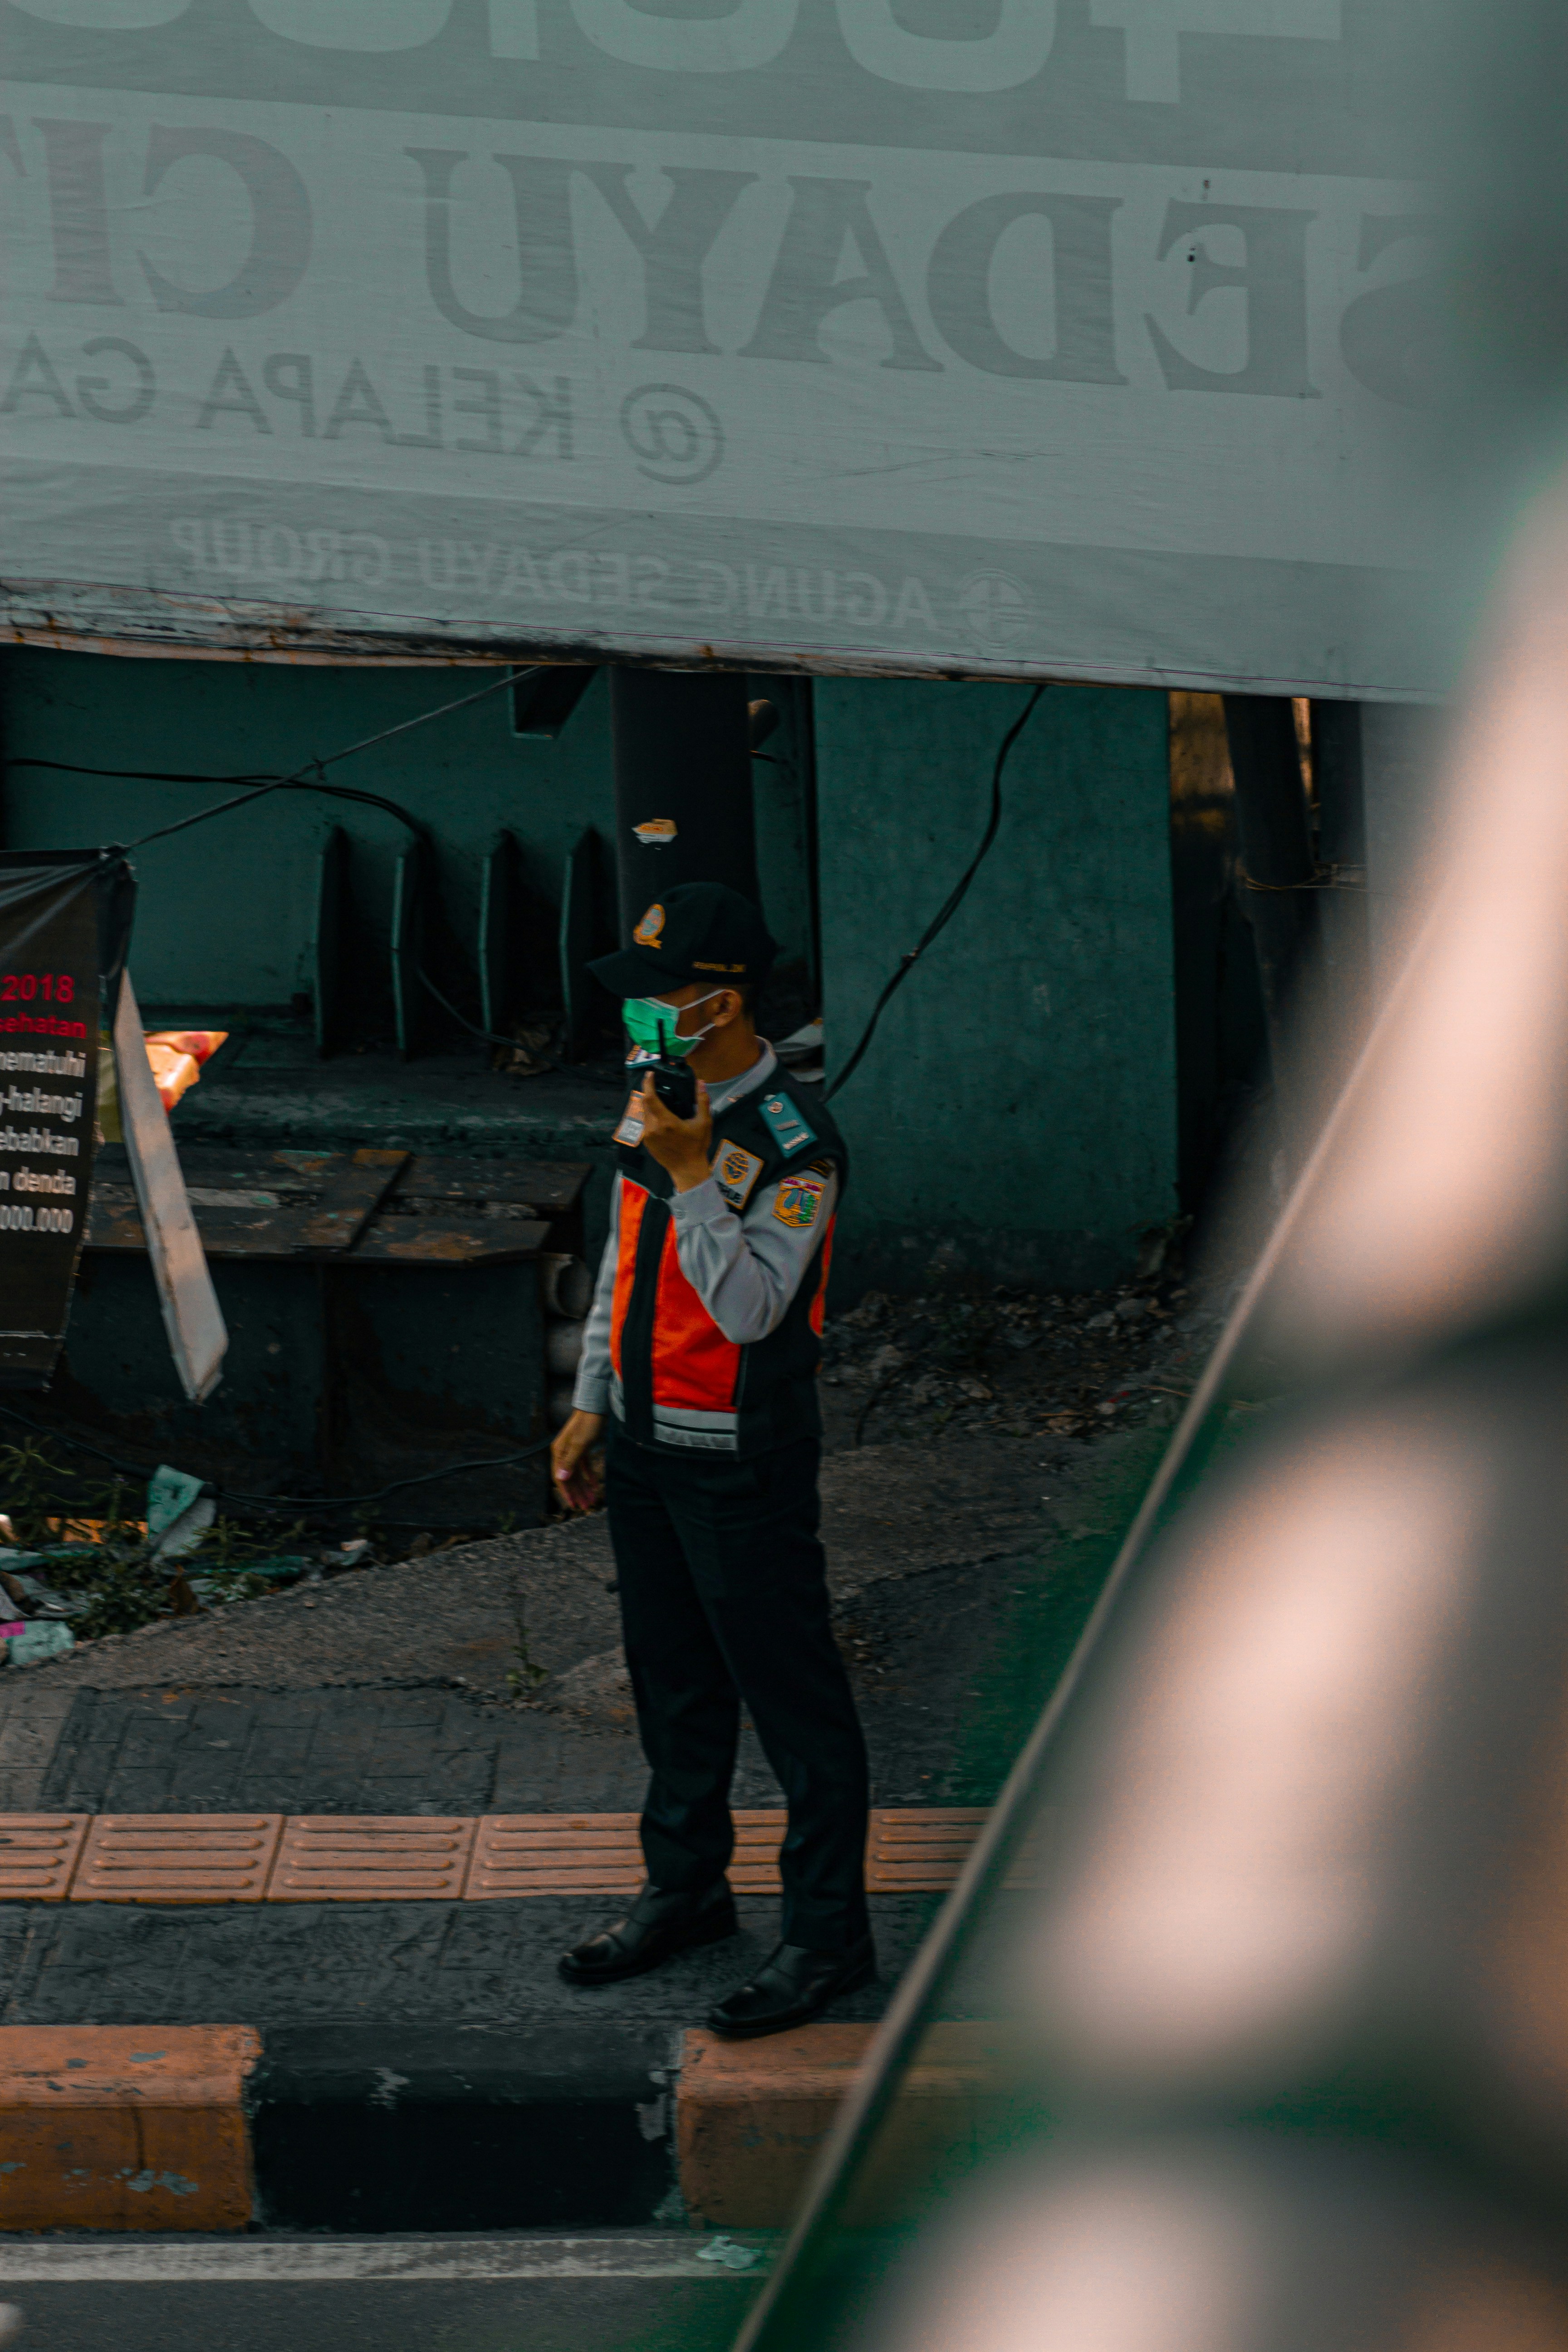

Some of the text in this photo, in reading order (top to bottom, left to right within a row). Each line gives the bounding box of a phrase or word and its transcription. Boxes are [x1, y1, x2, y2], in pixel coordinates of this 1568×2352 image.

[0, 973, 74, 1003] 2018
[0, 1084, 83, 1123] -halangi
[12, 1166, 77, 1195] denda
